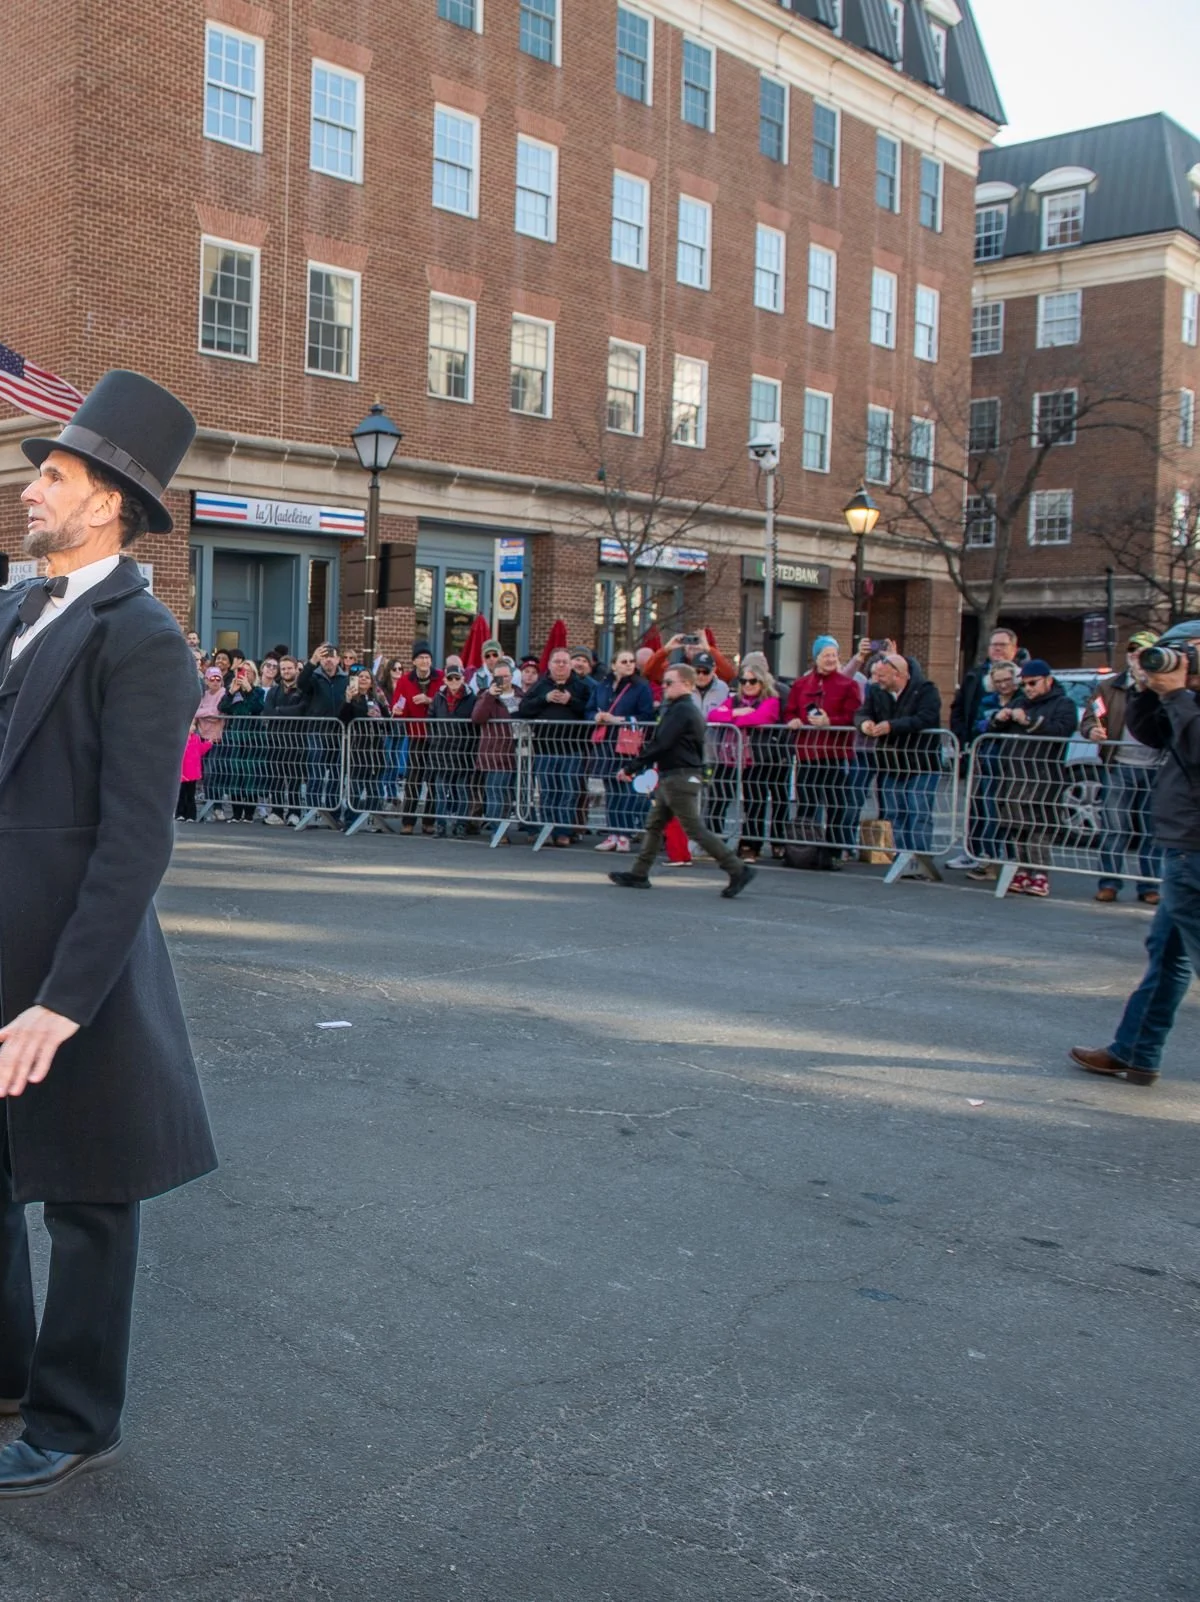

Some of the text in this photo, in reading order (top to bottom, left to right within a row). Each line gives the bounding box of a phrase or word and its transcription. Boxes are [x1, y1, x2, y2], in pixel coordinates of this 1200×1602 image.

[255, 503, 313, 526] la Madeleine
[795, 566, 820, 585] BANK
